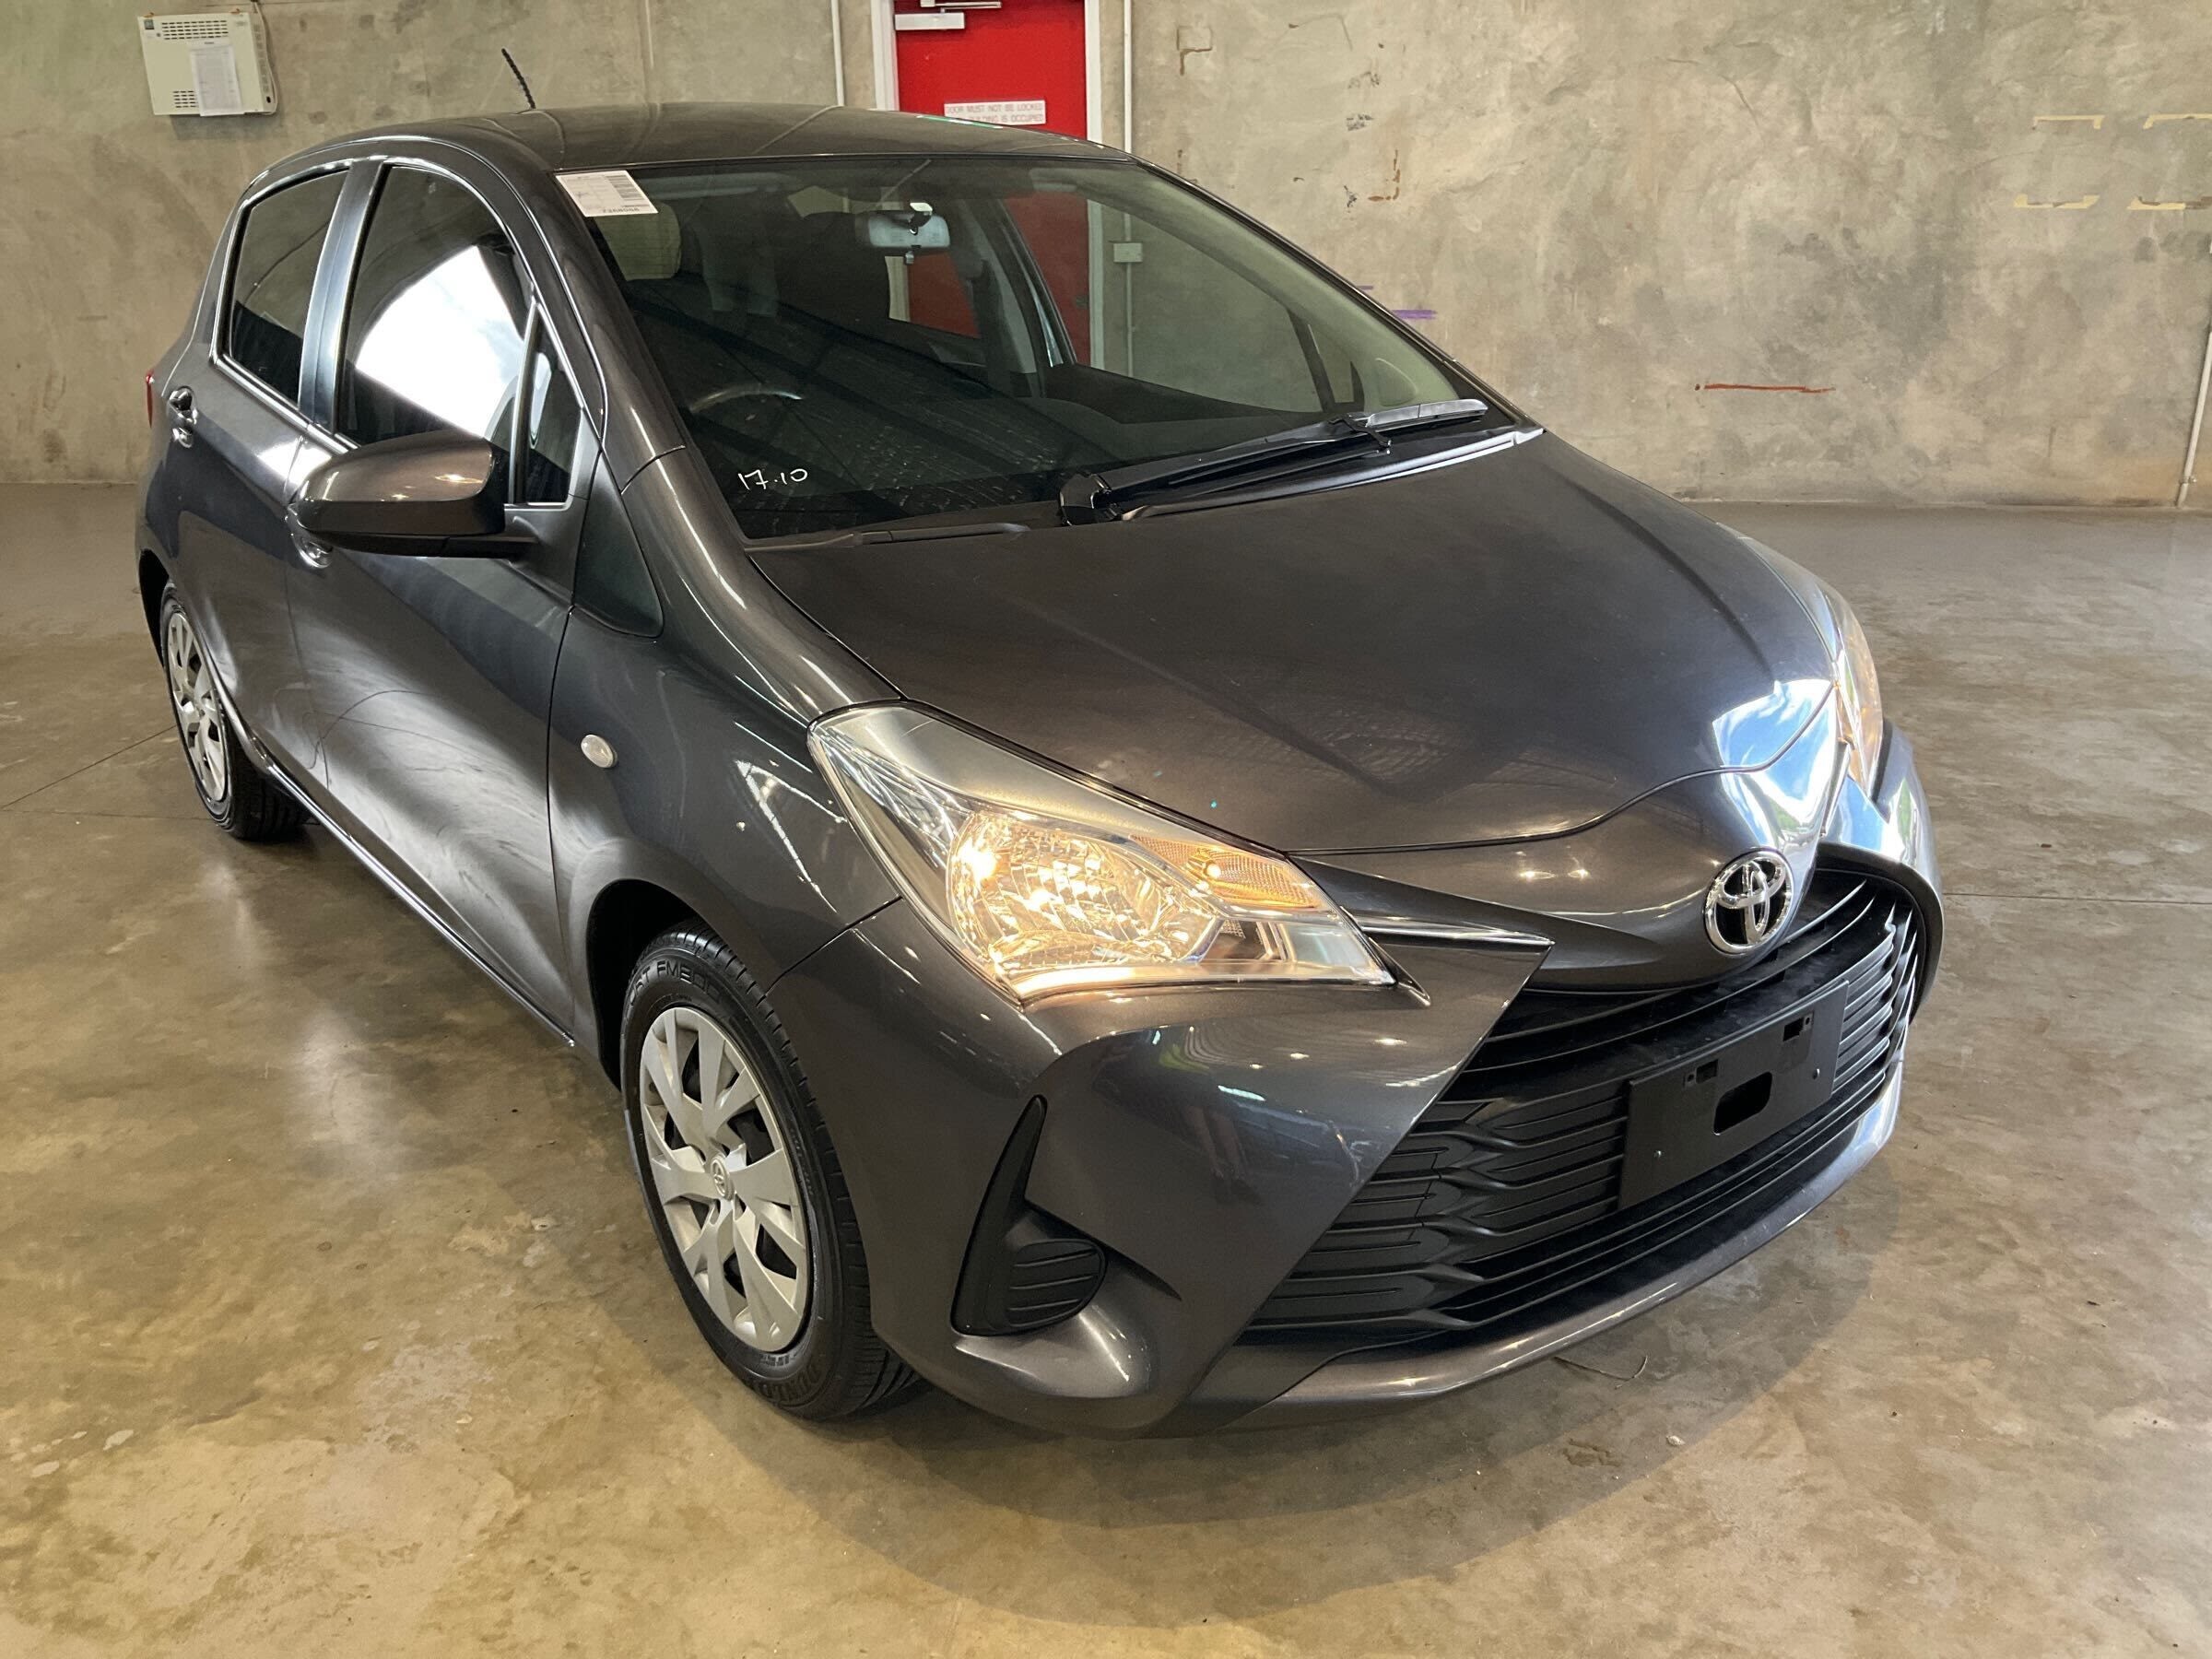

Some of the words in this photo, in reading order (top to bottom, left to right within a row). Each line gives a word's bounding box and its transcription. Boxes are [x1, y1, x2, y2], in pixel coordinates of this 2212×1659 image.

[988, 104, 1002, 112] NOT
[1018, 103, 1042, 112] LOCKED
[1011, 114, 1043, 123] OCCUPIED
[737, 468, 808, 490] 17.10
